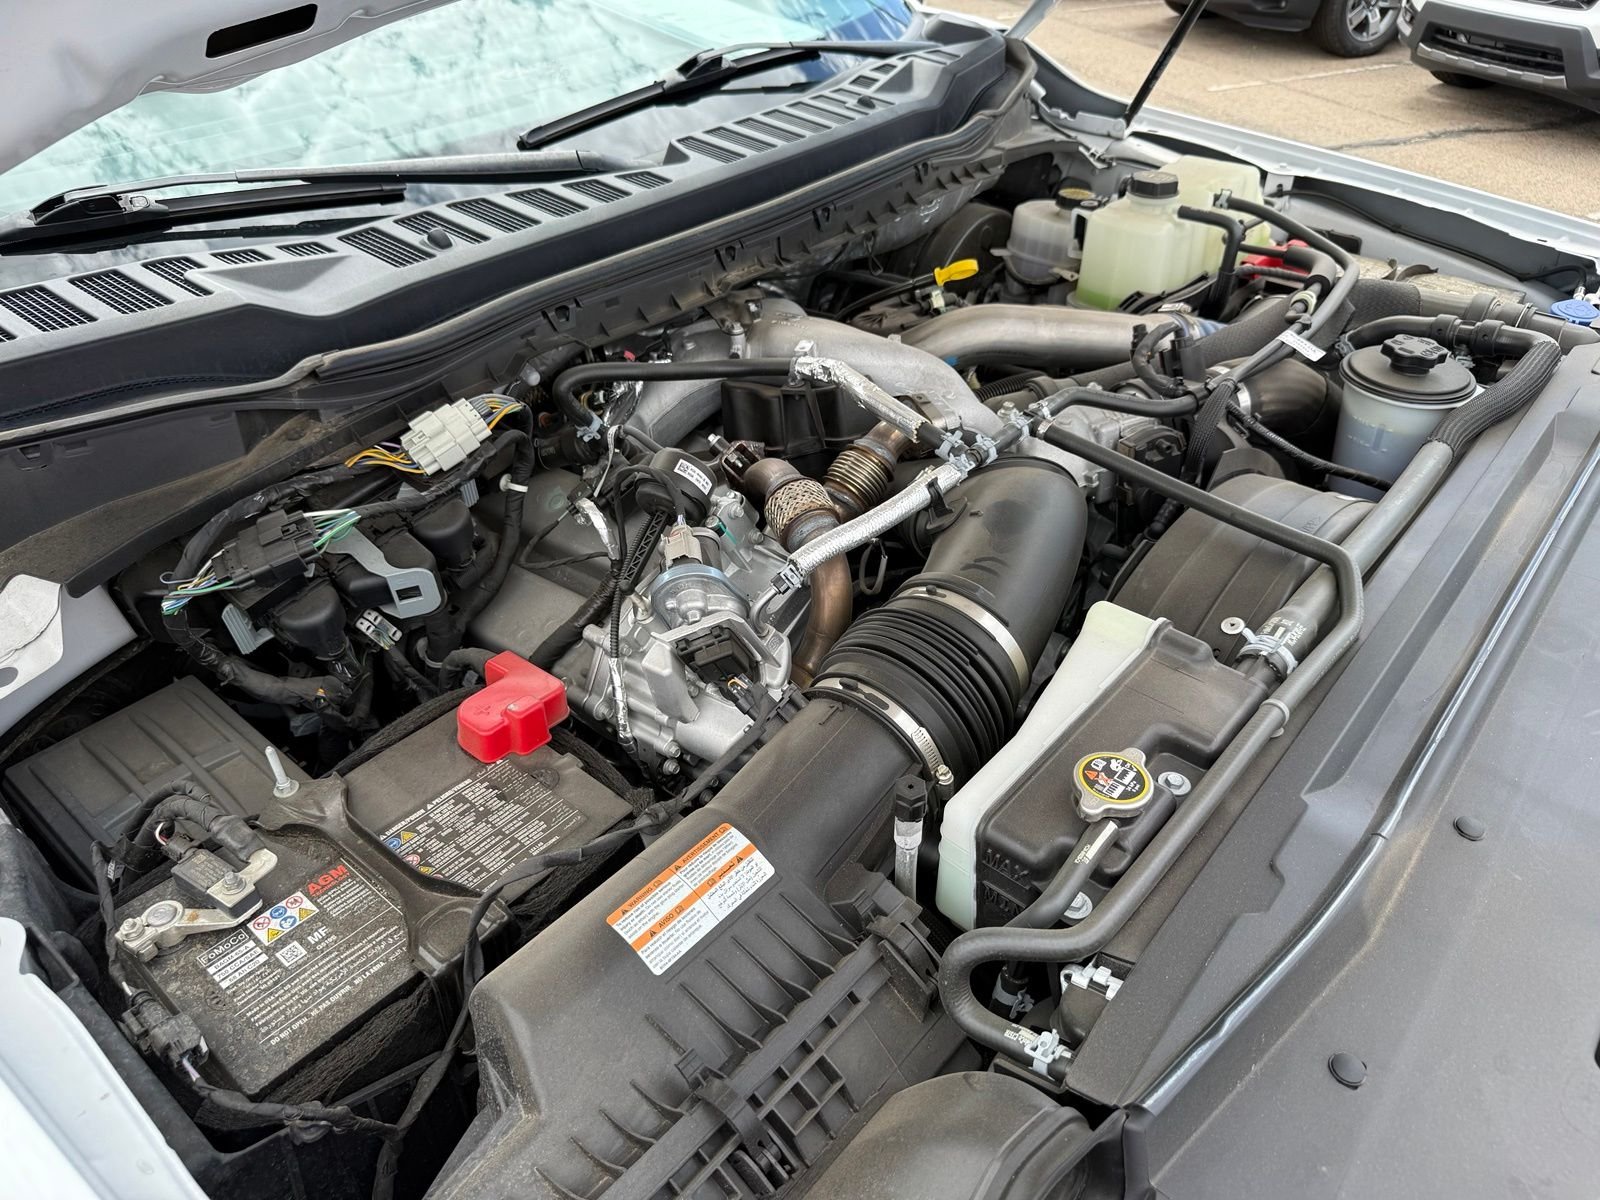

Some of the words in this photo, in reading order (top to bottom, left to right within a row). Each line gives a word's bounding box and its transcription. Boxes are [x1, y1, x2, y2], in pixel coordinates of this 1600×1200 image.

[681, 831, 719, 863] AVERTISSEMENT
[306, 863, 348, 895] AGM
[627, 886, 652, 908] WARNING
[657, 912, 674, 928] AVISO
[306, 925, 331, 944] MF
[199, 931, 246, 964] FoMoCo
[269, 1035, 280, 1045] DO
[278, 1026, 293, 1038] NOT
